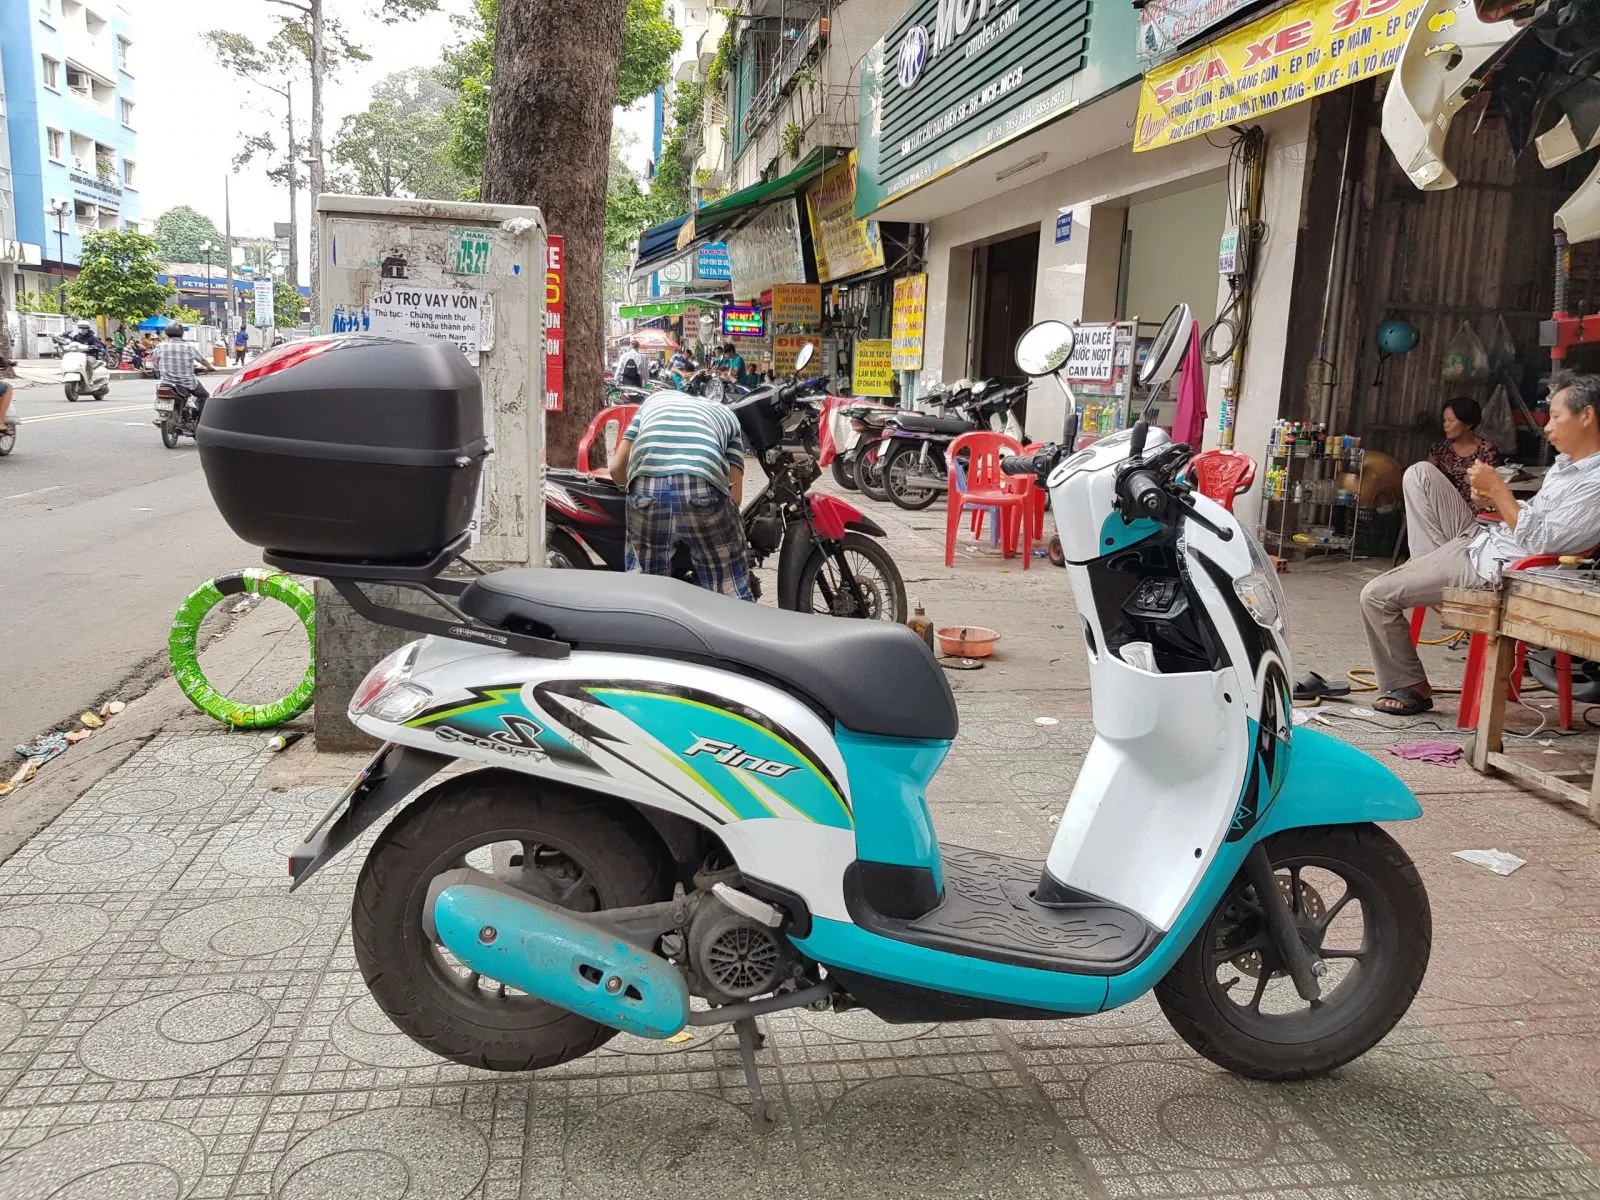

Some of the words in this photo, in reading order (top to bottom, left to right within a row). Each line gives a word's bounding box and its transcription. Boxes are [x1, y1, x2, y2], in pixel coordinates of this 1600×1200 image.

[1260, 64, 1278, 84] CON
[1331, 37, 1345, 59] ÉP
[1386, 15, 1401, 38] ÉP
[1155, 57, 1229, 106] SỬA
[1242, 19, 1314, 71] XE
[981, 82, 998, 107] MCB
[1000, 66, 1024, 96] MCCB
[1260, 91, 1279, 110] HAO
[547, 246, 561, 270] E
[182, 281, 234, 290] PETROLIME
[395, 292, 422, 309] TRỢ
[425, 293, 449, 308] VAY
[451, 291, 477, 309] VỐN
[410, 311, 433, 321] Chứng
[435, 312, 453, 320] minh
[454, 314, 467, 322] thư
[1074, 329, 1090, 346] BÁN
[1091, 331, 1112, 346] CAFE
[1092, 348, 1112, 361] NGỌT
[1068, 366, 1088, 377] CAM
[683, 735, 804, 778] Fino
